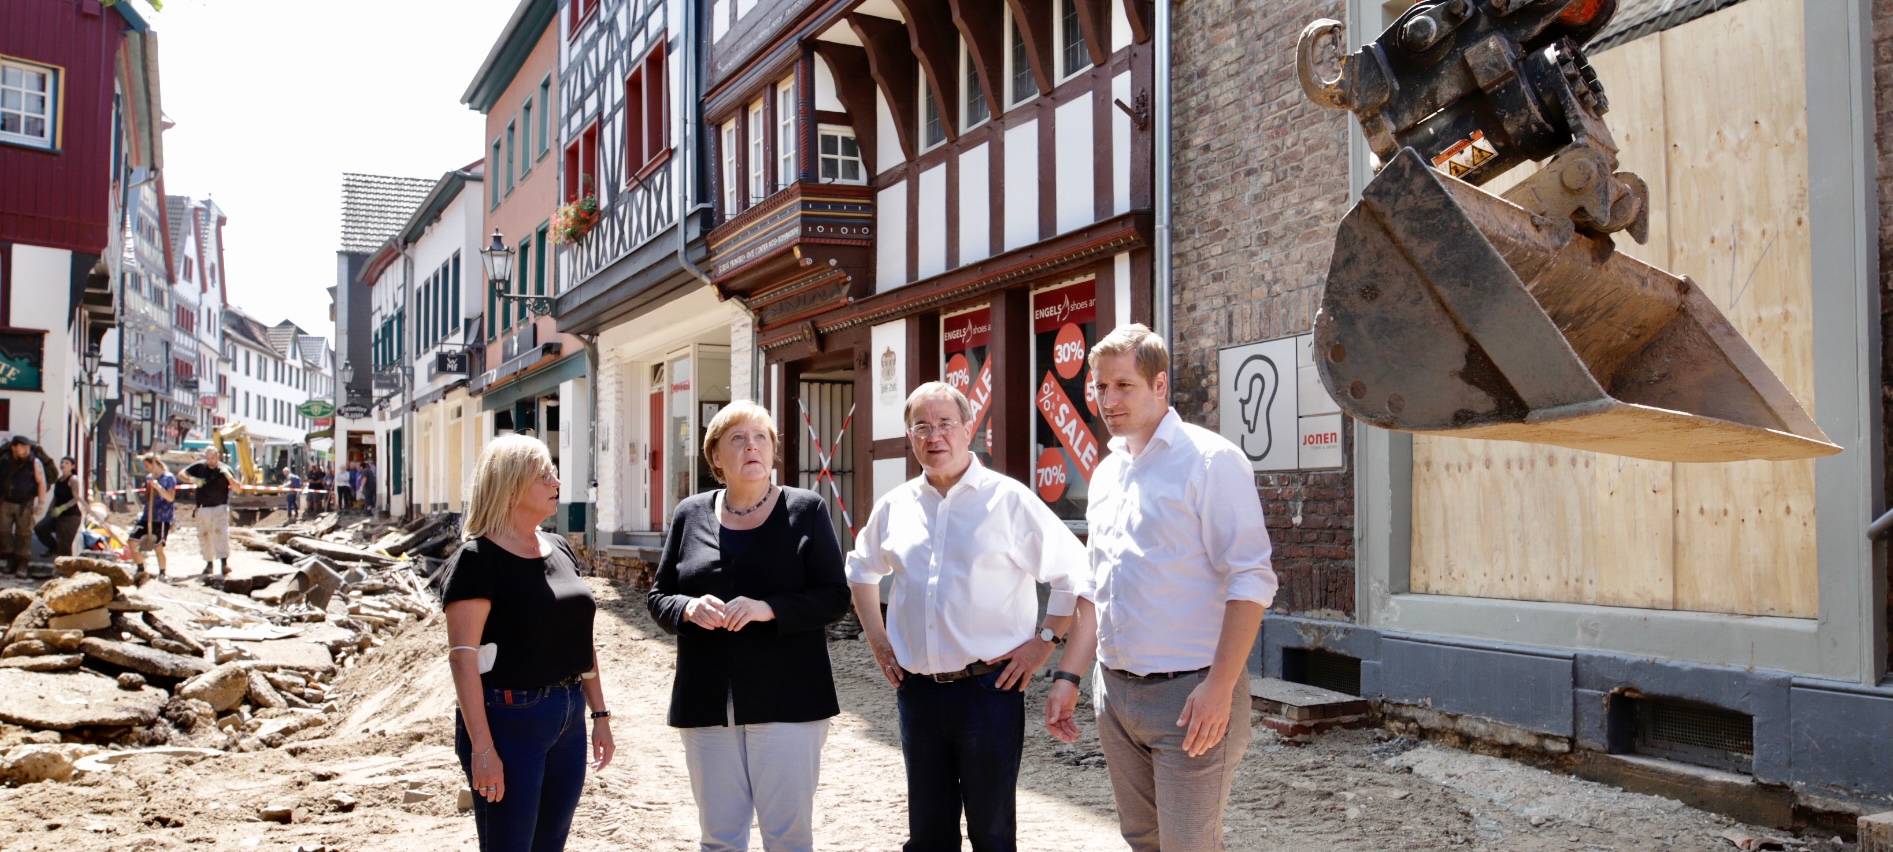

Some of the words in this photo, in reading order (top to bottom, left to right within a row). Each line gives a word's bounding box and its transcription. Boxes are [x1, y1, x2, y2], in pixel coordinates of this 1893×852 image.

[1035, 304, 1062, 320] ENGELS
[1070, 300, 1087, 312] shoes
[944, 328, 966, 342] ENGELS
[973, 324, 987, 335] shoes
[1055, 340, 1085, 364] 30%
[946, 367, 970, 388] 70%
[971, 367, 992, 423] ALE
[1055, 403, 1098, 472] SALE
[1302, 432, 1337, 446] JONEN
[1037, 464, 1066, 487] 70%
